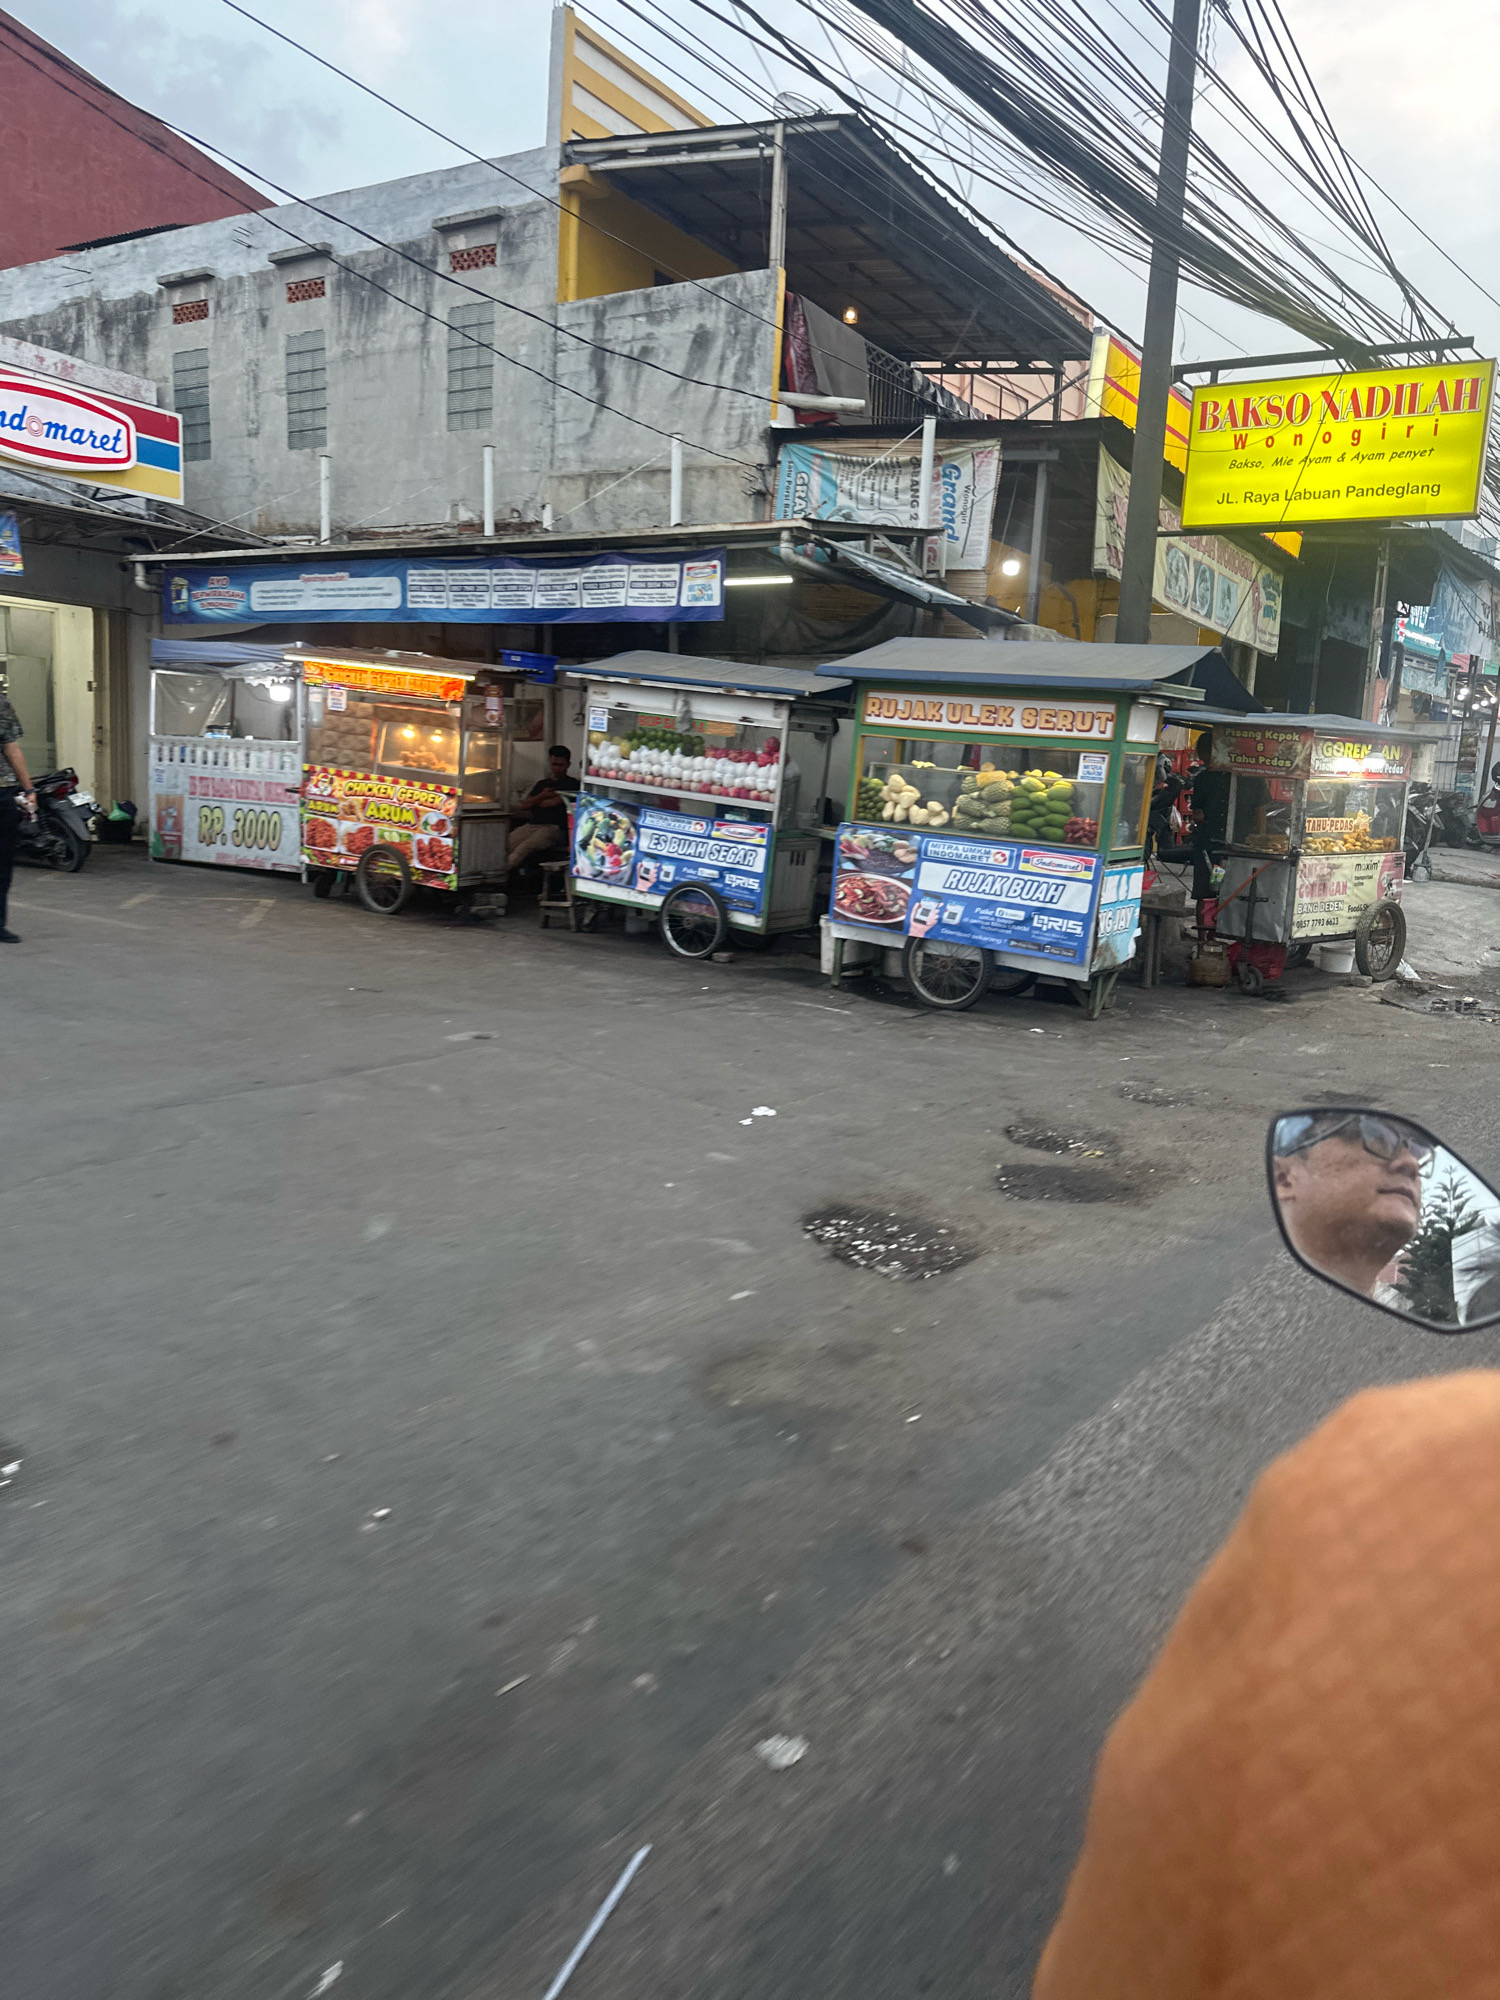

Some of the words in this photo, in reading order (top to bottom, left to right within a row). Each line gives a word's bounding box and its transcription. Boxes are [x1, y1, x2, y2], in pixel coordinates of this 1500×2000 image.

[1198, 392, 1312, 432] BAKSO
[1318, 377, 1484, 424] NADILAH
[1228, 459, 1265, 470] Bakso,
[1272, 456, 1294, 467] Mie
[1298, 455, 1332, 467] Ayam
[1336, 452, 1346, 462] &
[1351, 450, 1385, 464] Ayam
[1388, 447, 1435, 462] penyet
[784, 480, 792, 501] Porsi
[941, 462, 962, 541] Grand
[1217, 493, 1238, 505] JL.
[1243, 491, 1280, 506] Raya
[1284, 487, 1340, 501] Labuan
[1346, 482, 1441, 499] Pandeglang
[960, 484, 972, 524] Wonogiri
[208, 577, 229, 587] AYO
[865, 696, 943, 722] RUJAK
[947, 702, 1014, 727] ULEK
[1021, 707, 1114, 735] SERUT
[1229, 754, 1255, 764] Tahu
[1322, 741, 1400, 760] GORENAN
[344, 781, 396, 799] CHICKEN
[397, 787, 444, 810] GEPREK
[365, 800, 417, 827] ARUM
[232, 808, 281, 851] 3000
[647, 833, 668, 851] ES
[667, 837, 709, 859] BUAH
[708, 844, 757, 867] SEGAR
[929, 849, 991, 863] INDOMARET
[930, 842, 959, 852] MITRA
[962, 846, 991, 856] UMKM
[1355, 860, 1378, 871] maxim
[943, 870, 1009, 897] RUJAK
[1007, 877, 1066, 904] BUAH
[1297, 902, 1318, 914] BANG
[1320, 900, 1344, 913] DEDEN
[1032, 914, 1083, 934] QRIS
